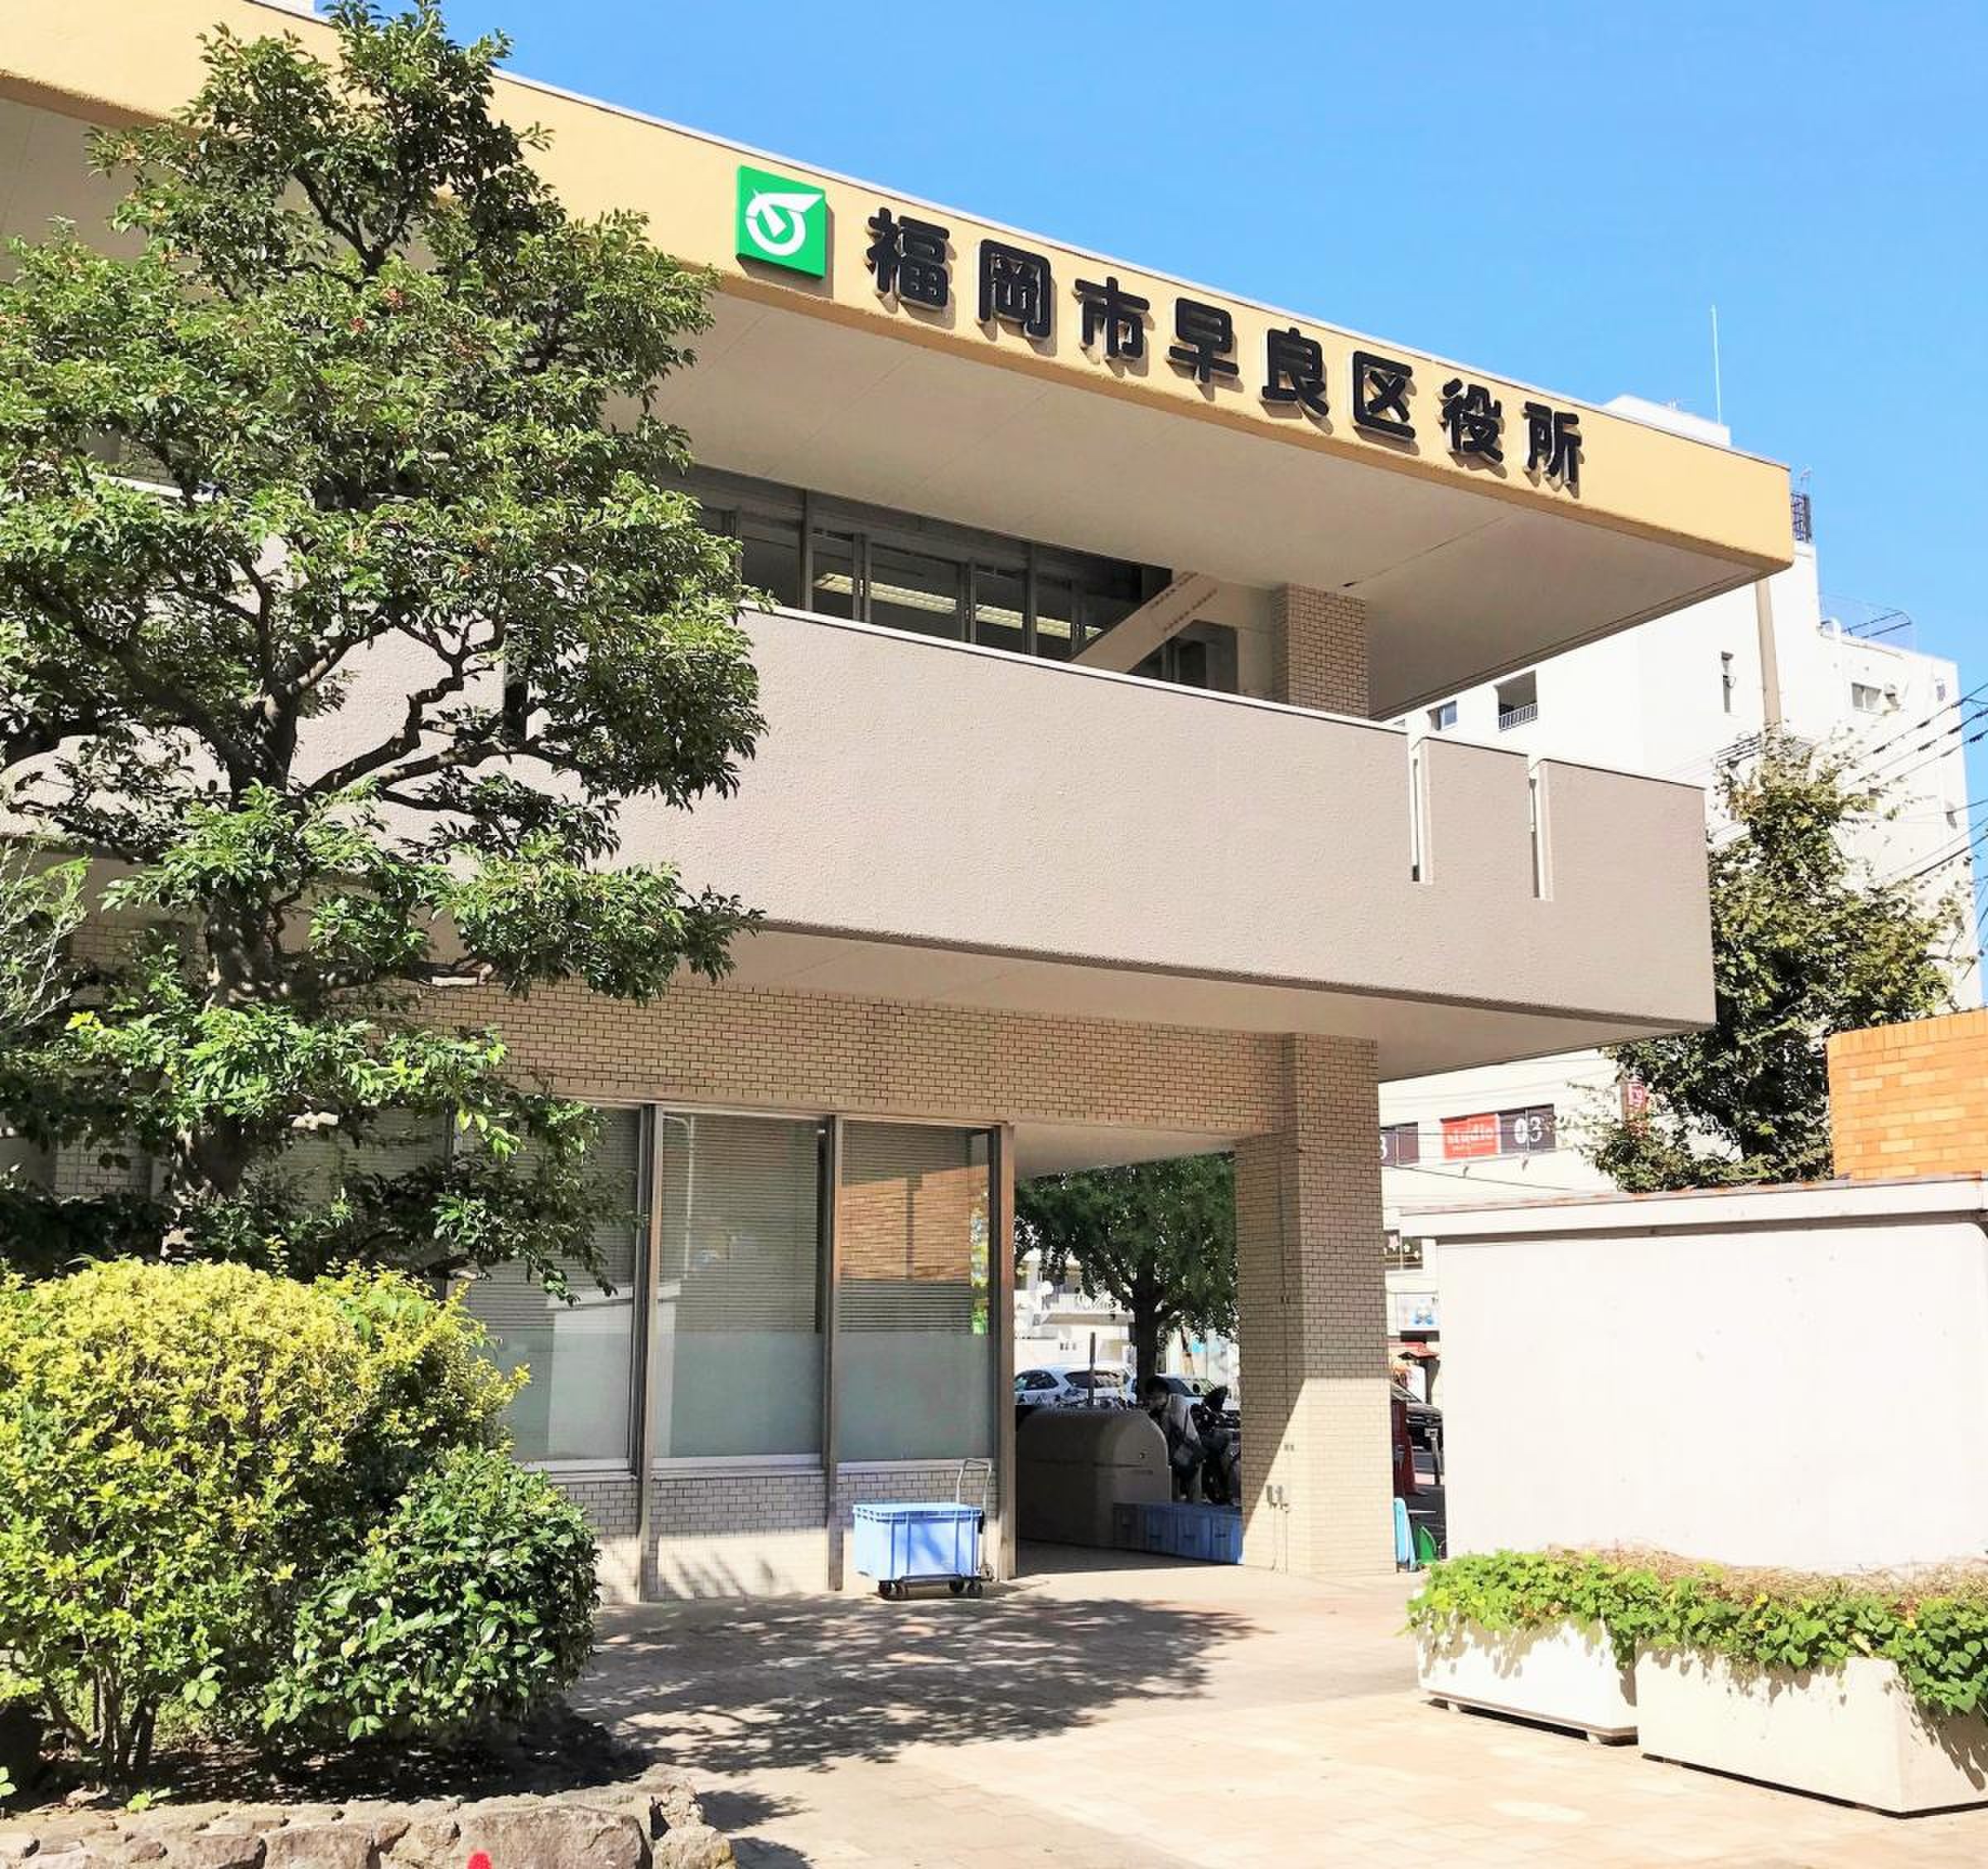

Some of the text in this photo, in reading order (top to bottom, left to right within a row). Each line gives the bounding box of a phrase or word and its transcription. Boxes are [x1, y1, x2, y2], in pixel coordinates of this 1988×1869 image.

[865, 207, 1584, 490] 福岡市早良区役所
